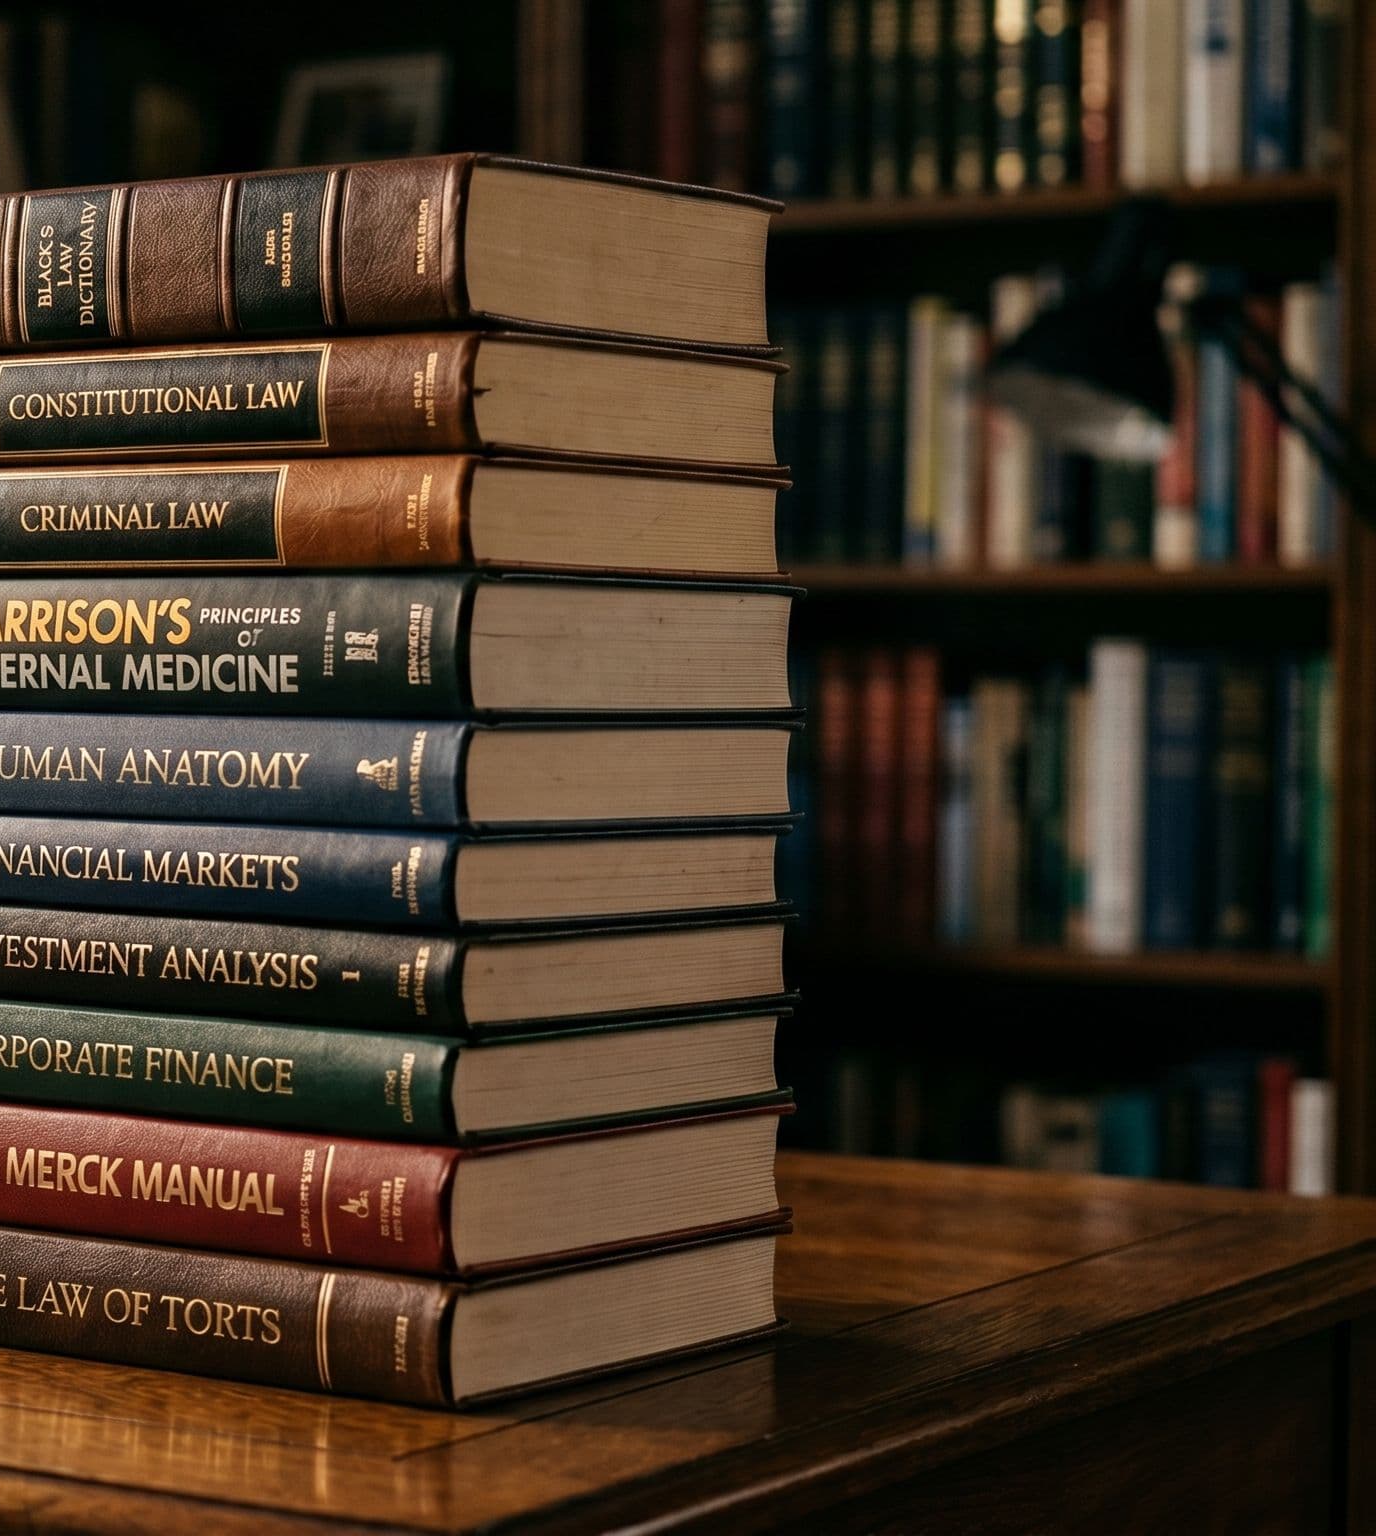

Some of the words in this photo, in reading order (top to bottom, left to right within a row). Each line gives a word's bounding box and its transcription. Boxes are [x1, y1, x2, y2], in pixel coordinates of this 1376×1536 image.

[57, 242, 74, 288] LAW
[78, 201, 98, 326] DICTIONARY
[9, 384, 239, 421] CONSTITUTIONAL
[245, 381, 305, 410] LAW
[20, 502, 161, 533] CRIMINAL
[167, 501, 230, 530] LAW
[199, 606, 302, 625] PRINCIPLES
[121, 653, 300, 694] MEDICINE
[115, 747, 310, 790] ANATOMY
[141, 850, 301, 893] MARKETS
[159, 945, 319, 991] ANALYSIS
[144, 1046, 294, 1095] FINANCE
[5, 1146, 124, 1198] MERCK
[131, 1159, 285, 1217] MANUAL
[17, 1275, 94, 1320] LAW
[103, 1288, 151, 1327] OF
[159, 1295, 282, 1345] TORTS
